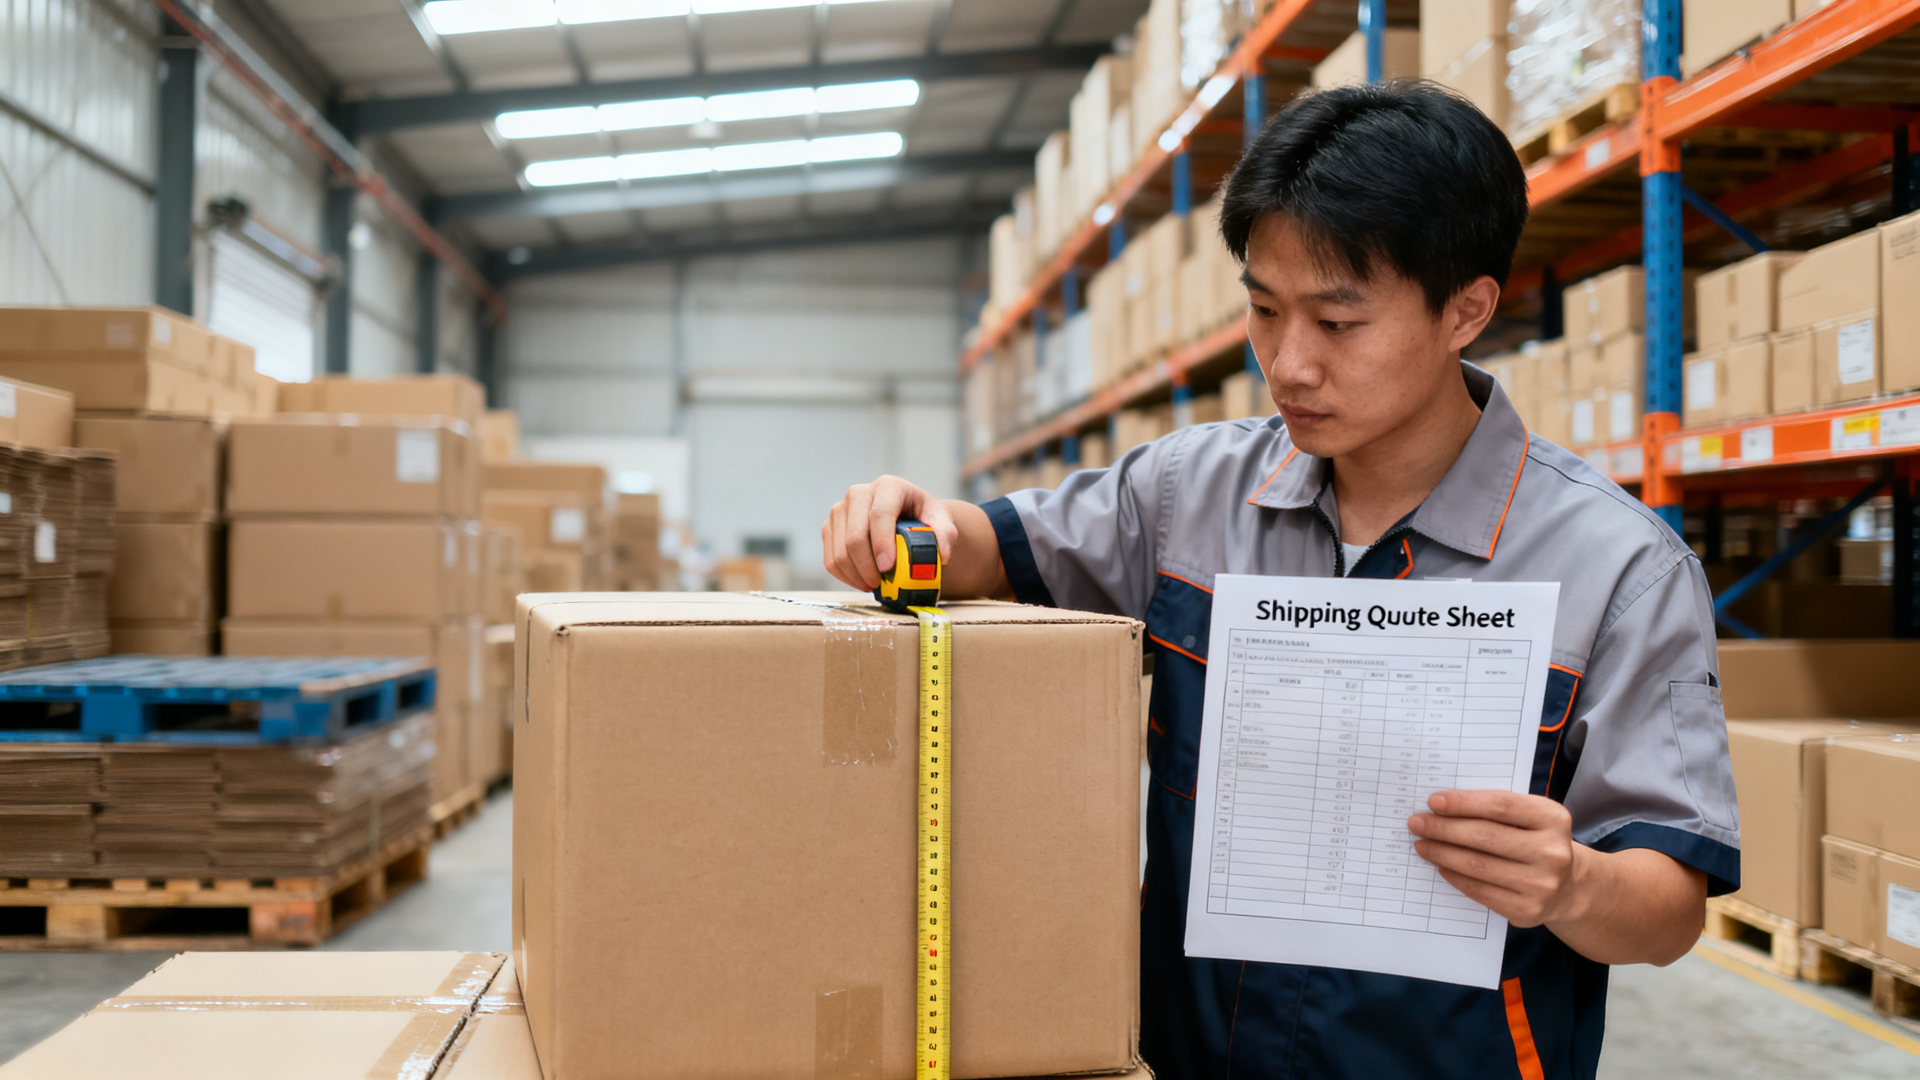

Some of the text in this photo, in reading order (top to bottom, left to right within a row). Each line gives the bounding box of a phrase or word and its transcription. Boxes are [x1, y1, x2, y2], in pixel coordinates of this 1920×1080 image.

[1256, 600, 1516, 631] Shipping Quute Sheet
